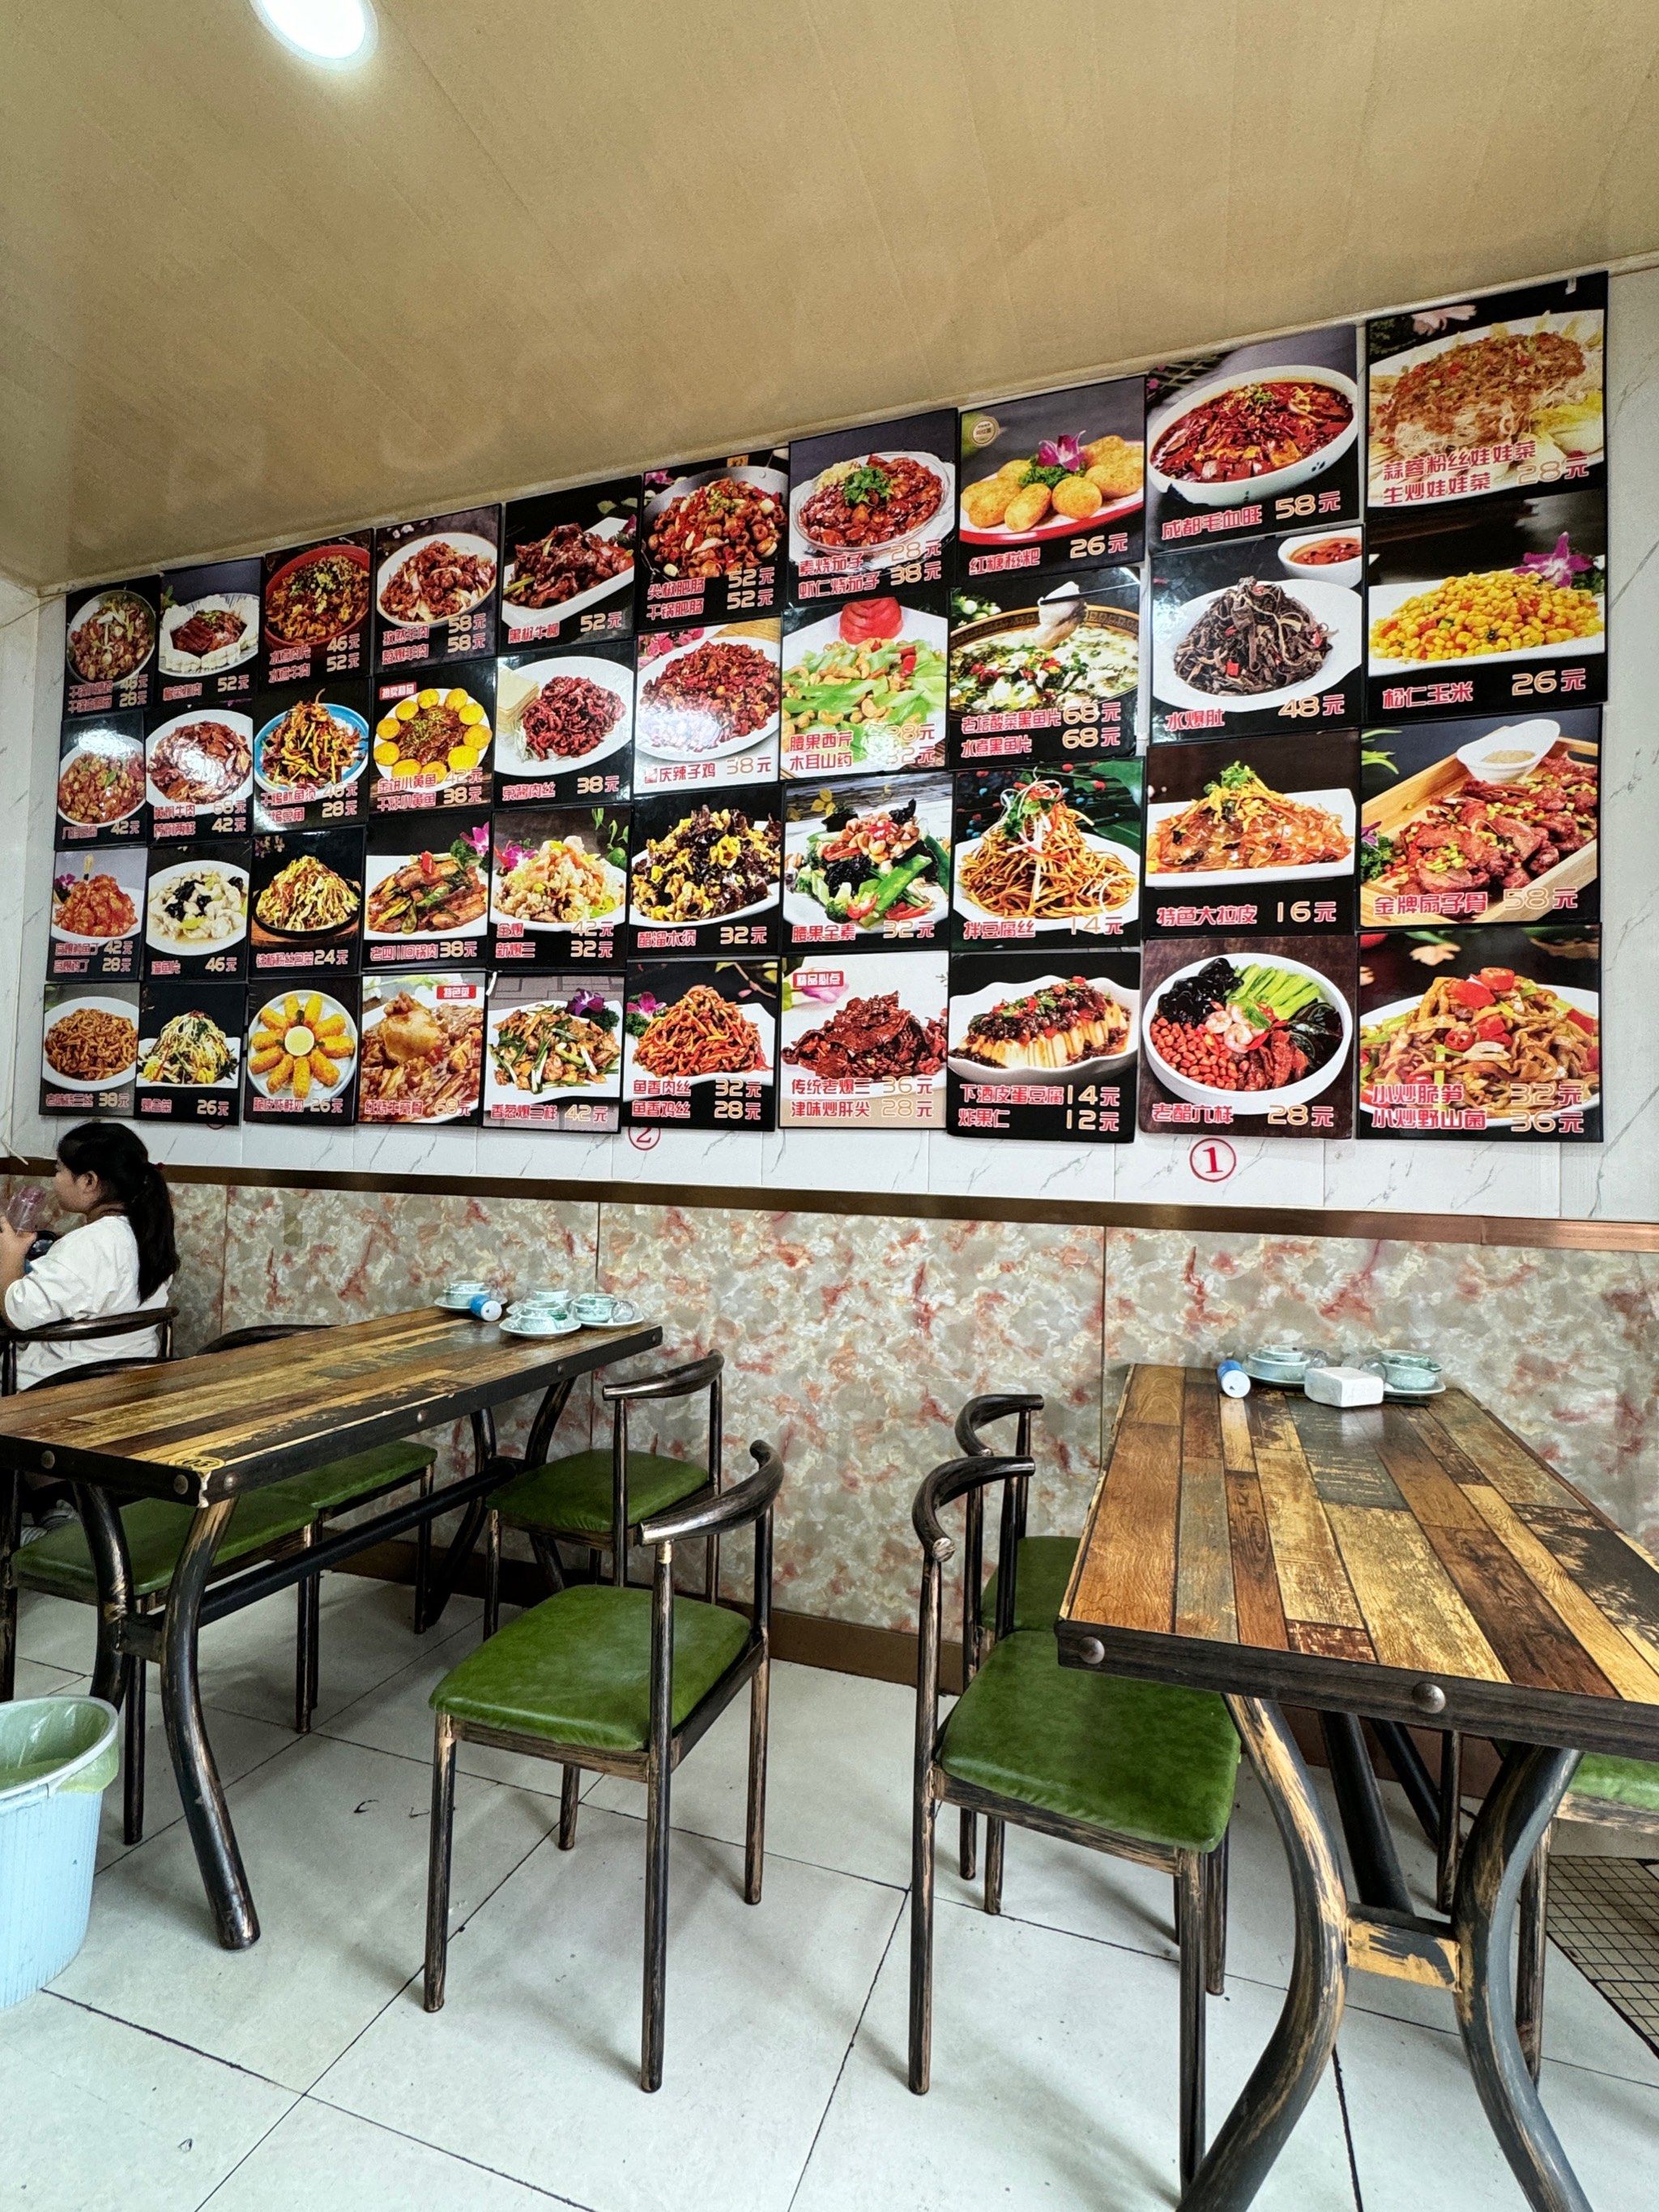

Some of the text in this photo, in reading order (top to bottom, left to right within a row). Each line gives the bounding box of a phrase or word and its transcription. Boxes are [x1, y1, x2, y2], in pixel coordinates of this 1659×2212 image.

[1384, 440, 1536, 481] 蒜蓉粉丝娃娃菜
[1384, 455, 1589, 506] 生炒娃娃菜 28元
[1162, 490, 1341, 540] 成都毛血旺 58元
[799, 539, 941, 577] 素烧茄子 28元
[969, 532, 1128, 575] 红糖糍粑 26元
[647, 566, 775, 601] 尖椒肥肠 52元
[798, 561, 941, 599] 虾仁烧茄子 38元
[646, 588, 774, 621] 干锅肥肠 52元
[383, 613, 486, 646] 孜然羊肉 58元
[508, 611, 622, 644] 黑椒牛柳 52元
[269, 633, 360, 664] 水煮肉片 46元
[447, 632, 486, 653] 58元
[268, 652, 360, 683] 水煮牛肉 52元
[217, 674, 249, 692] 52元
[1383, 668, 1585, 710] 松仁玉米 26元
[119, 690, 147, 708] 28元
[962, 702, 1121, 734] 老坛酸菜黑鱼片 68元
[1165, 694, 1345, 732] 水爆肚 48元
[790, 731, 852, 751] 腰果西芹
[962, 727, 1121, 758] 水煮黑鱼片 68元
[727, 756, 771, 775] 38元
[790, 752, 852, 771] 木耳山药
[445, 767, 484, 784] 42元
[323, 782, 358, 800] 46元
[443, 786, 482, 805] 38元
[502, 775, 620, 801] 京酱肉丝 38元
[214, 800, 246, 815] 68元
[322, 800, 358, 819] 28元
[110, 820, 140, 835] 42元
[211, 817, 246, 833] 42元
[1375, 886, 1578, 915] 金牌扇子骨 58元
[1157, 901, 1337, 927] 特色大拉皮 16元
[497, 921, 615, 937] 全爆 42元
[638, 926, 767, 948] 醋溜木须 32元
[791, 920, 935, 943] 腰果全素 32元
[963, 914, 1124, 940] 拌豆腐丝 14元
[104, 940, 133, 955] 42元
[314, 949, 348, 965] 24元
[370, 941, 477, 962] 老四川回锅肉 38元
[495, 940, 612, 959] 新爆三 32元
[102, 958, 131, 972] 28元
[205, 957, 237, 972] 46元
[633, 1078, 761, 1098] 鱼香肉丝 32元
[791, 1076, 932, 1095] 传统老爆三 36元
[960, 1084, 1120, 1106] 下酒皮蛋豆腐 14元
[1372, 1083, 1584, 1106] 小炒脆笋 32元
[99, 1092, 130, 1108] 38元
[197, 1099, 229, 1116] 26元
[310, 1098, 343, 1113] 26元
[365, 1099, 471, 1117] 红烧牛窝骨 68元
[632, 1100, 761, 1120] 鱼香鸡丝 28元
[791, 1100, 932, 1117] 津味炒肝尖 28元
[490, 1104, 608, 1123] 香葱爆三样 42元
[958, 1108, 1120, 1131] 炸果仁 12元
[1152, 1102, 1334, 1127] 老醋六样 28元
[1372, 1108, 1584, 1134] 小炒野山菌 36元
